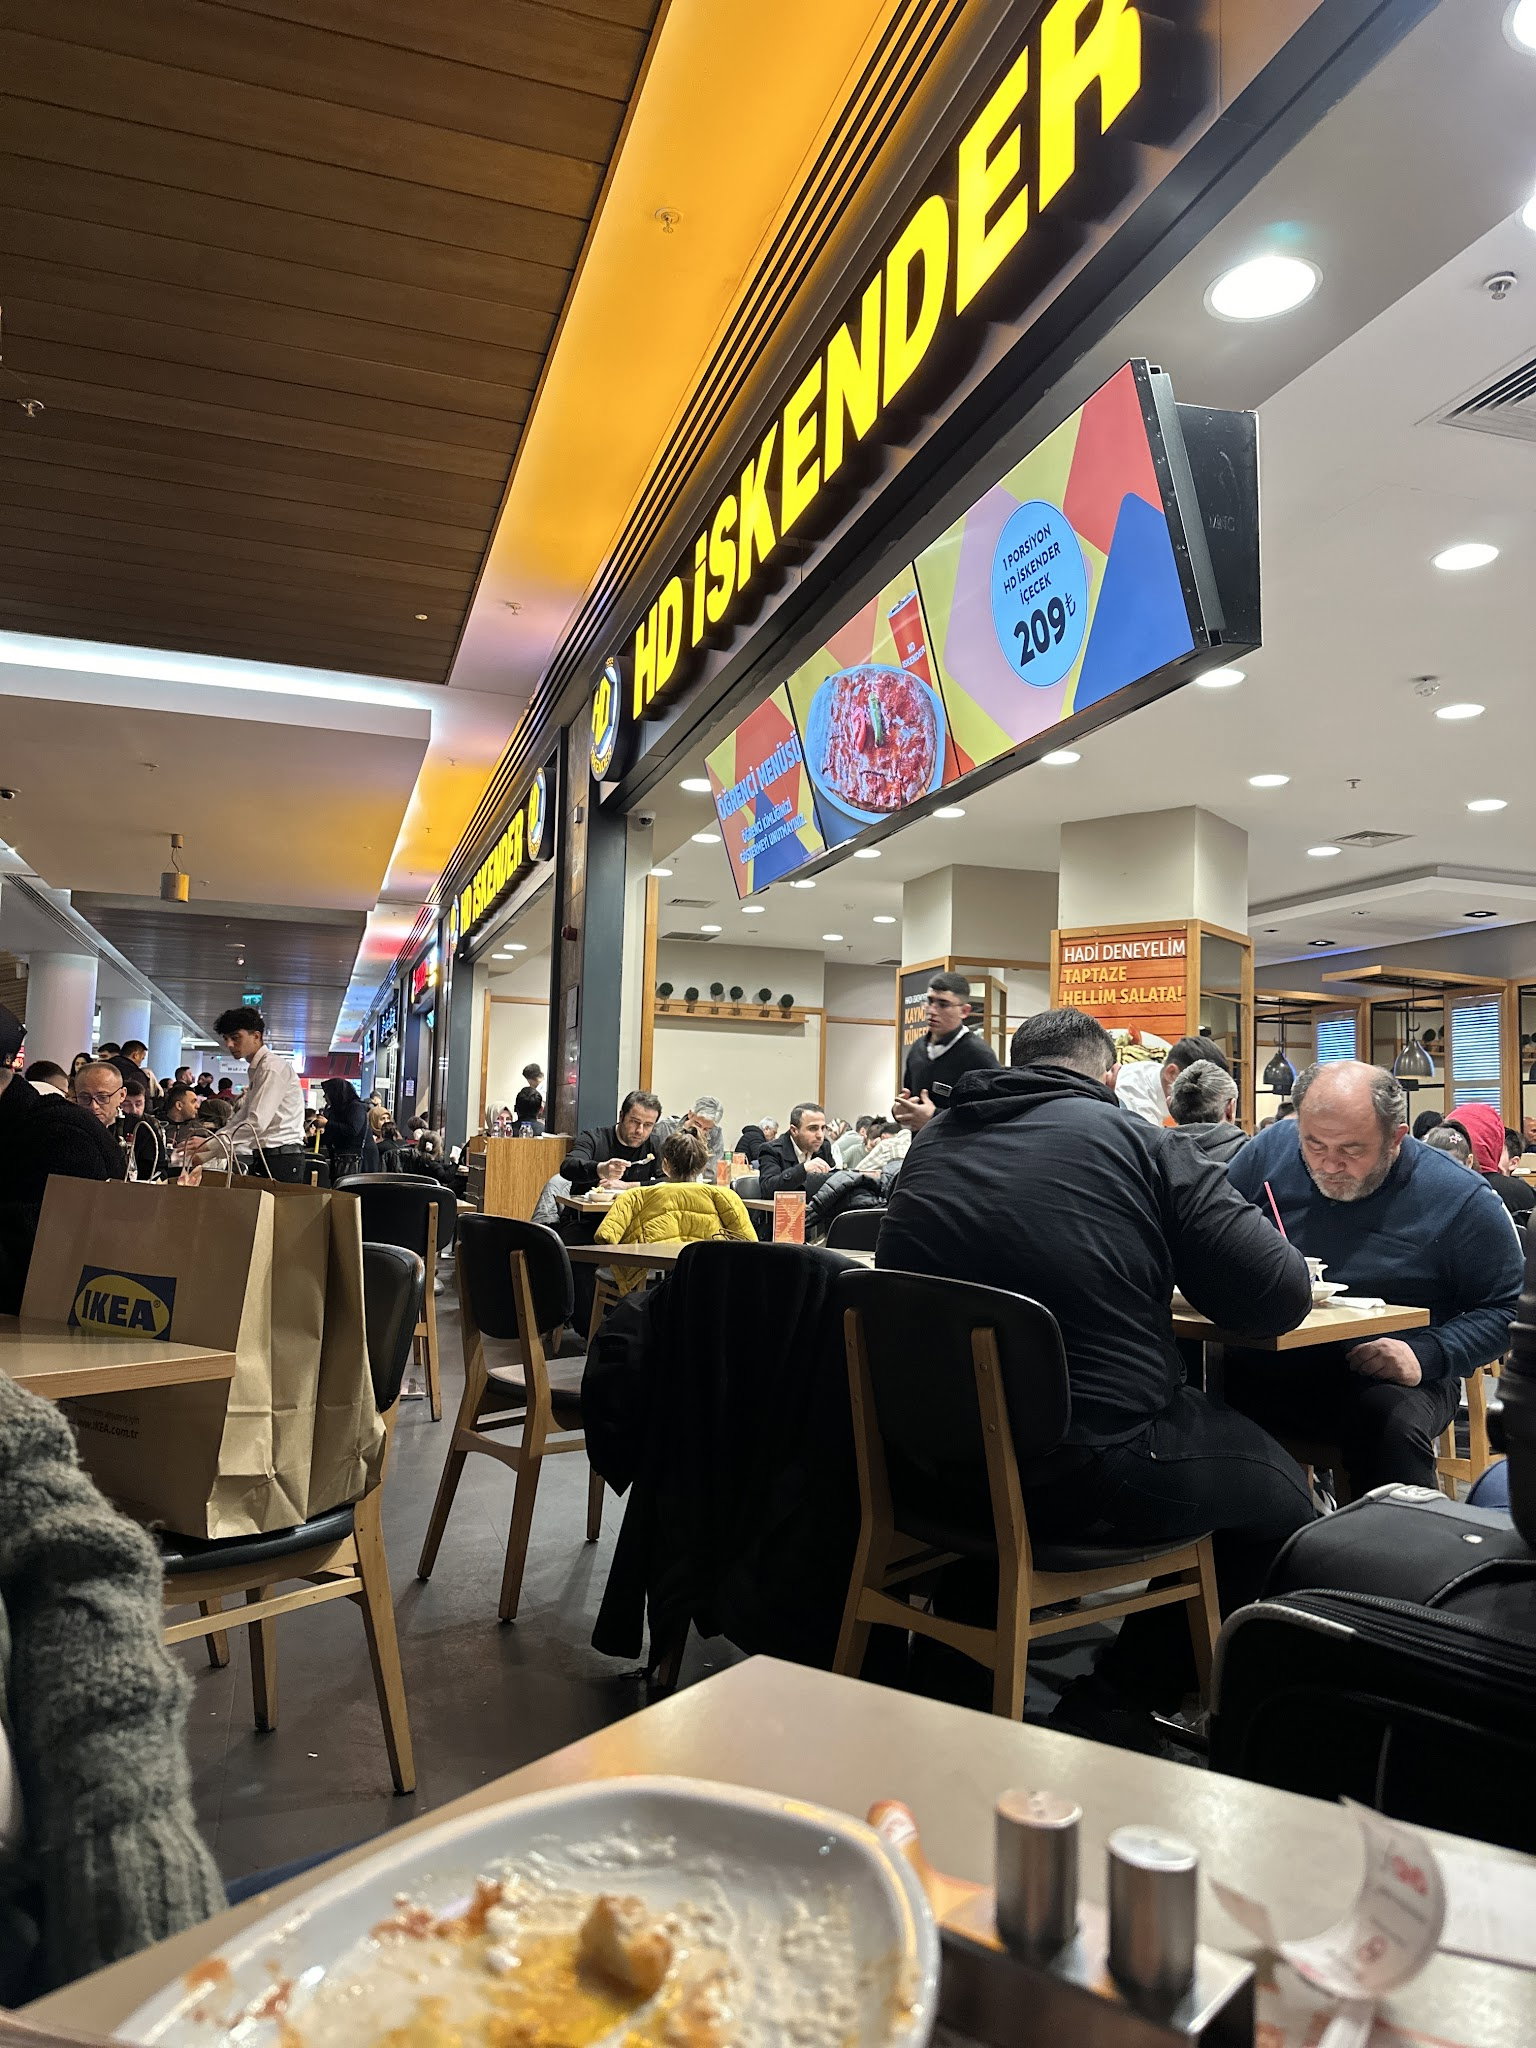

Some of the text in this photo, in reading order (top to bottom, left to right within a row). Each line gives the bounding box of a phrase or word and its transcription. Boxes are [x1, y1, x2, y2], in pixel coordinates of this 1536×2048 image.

[1002, 523, 1052, 571] 1 PORSİYON
[1003, 541, 1062, 595] HD İSKENDER
[1020, 573, 1053, 605] İÇECEK
[632, 586, 682, 720] HD
[716, 729, 803, 821] ÖĞRENCİ MENÜSÜ
[460, 808, 524, 938] HD İSKENDER
[1064, 937, 1186, 963] HADİ DENEYELİM
[1063, 966, 1127, 985] TAPTAZE
[905, 1007, 926, 1024] KAYM
[1062, 986, 1183, 1007] HELLİM SALATA!
